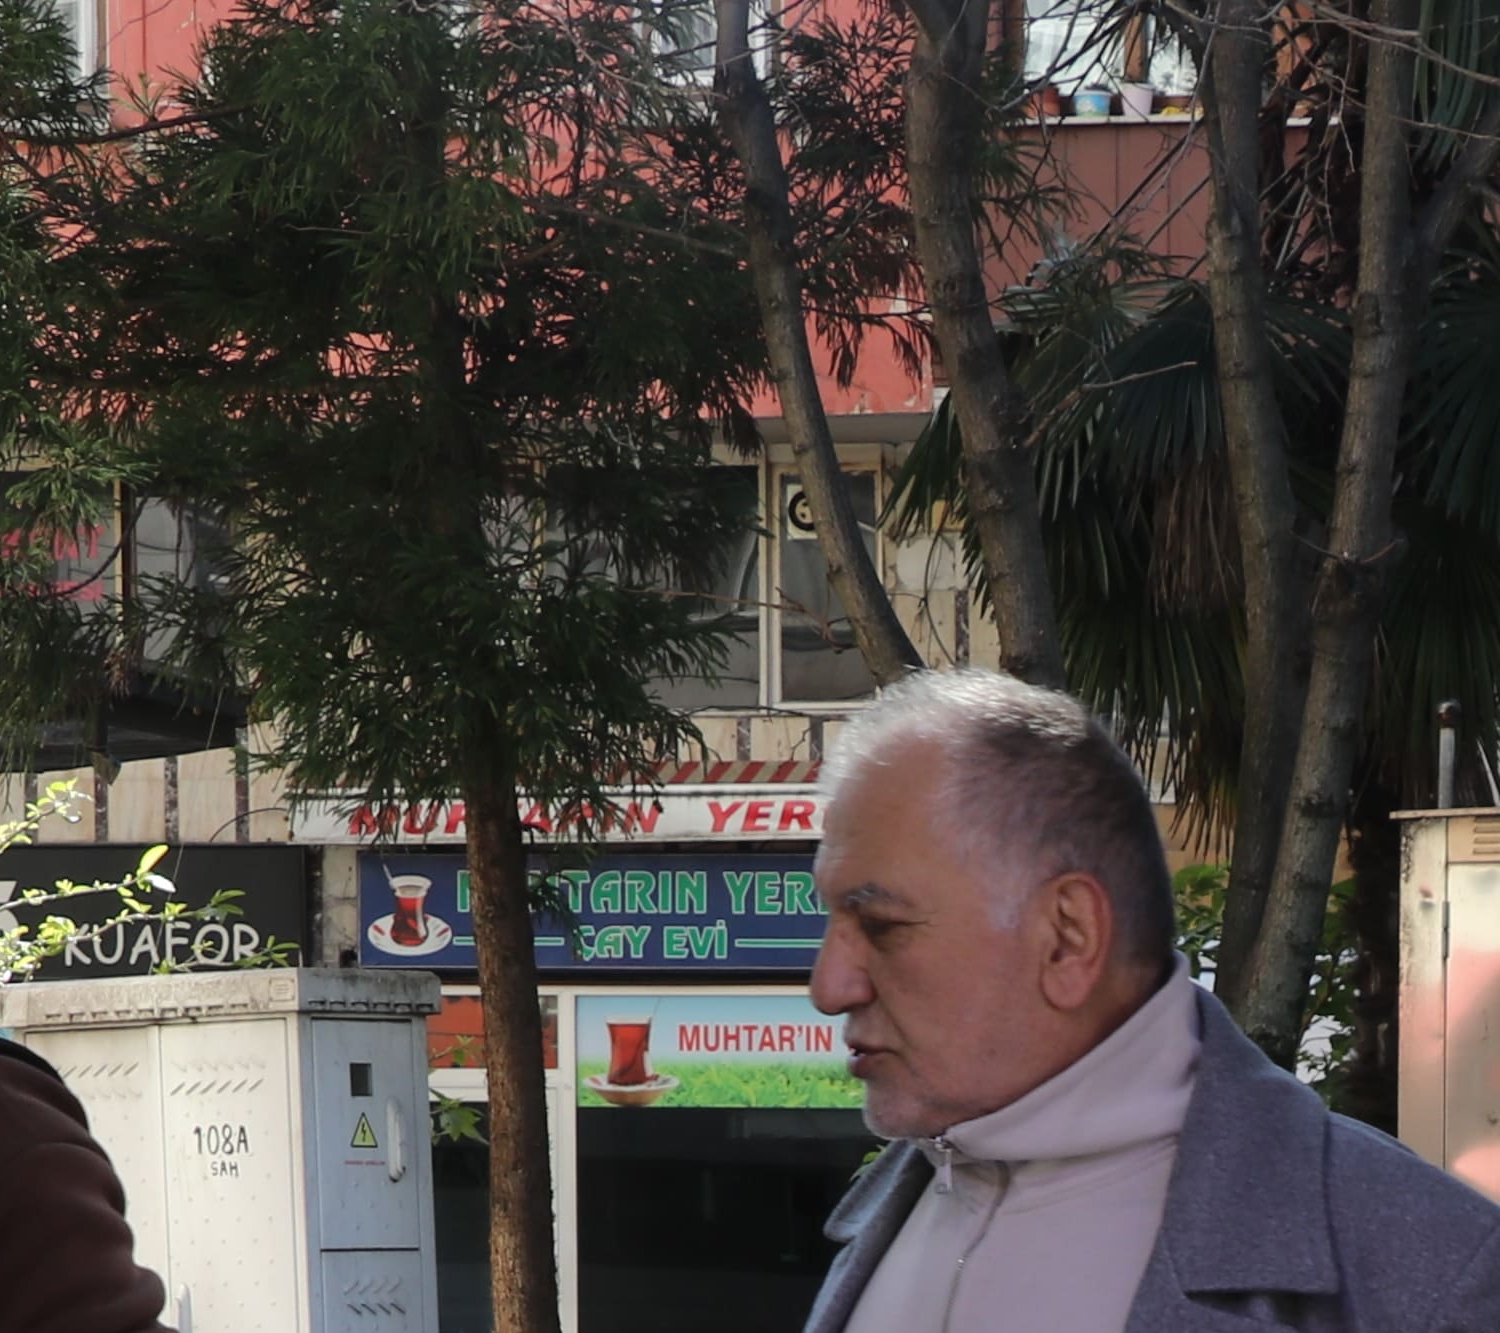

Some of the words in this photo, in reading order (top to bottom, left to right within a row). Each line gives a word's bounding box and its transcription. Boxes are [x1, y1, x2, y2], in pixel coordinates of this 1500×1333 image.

[707, 800, 828, 834] YER
[723, 870, 831, 915] YER
[579, 925, 651, 962] ÇAY
[663, 919, 728, 959] EVİ
[193, 1123, 249, 1156] 108A
[211, 1161, 239, 1178] SAH
